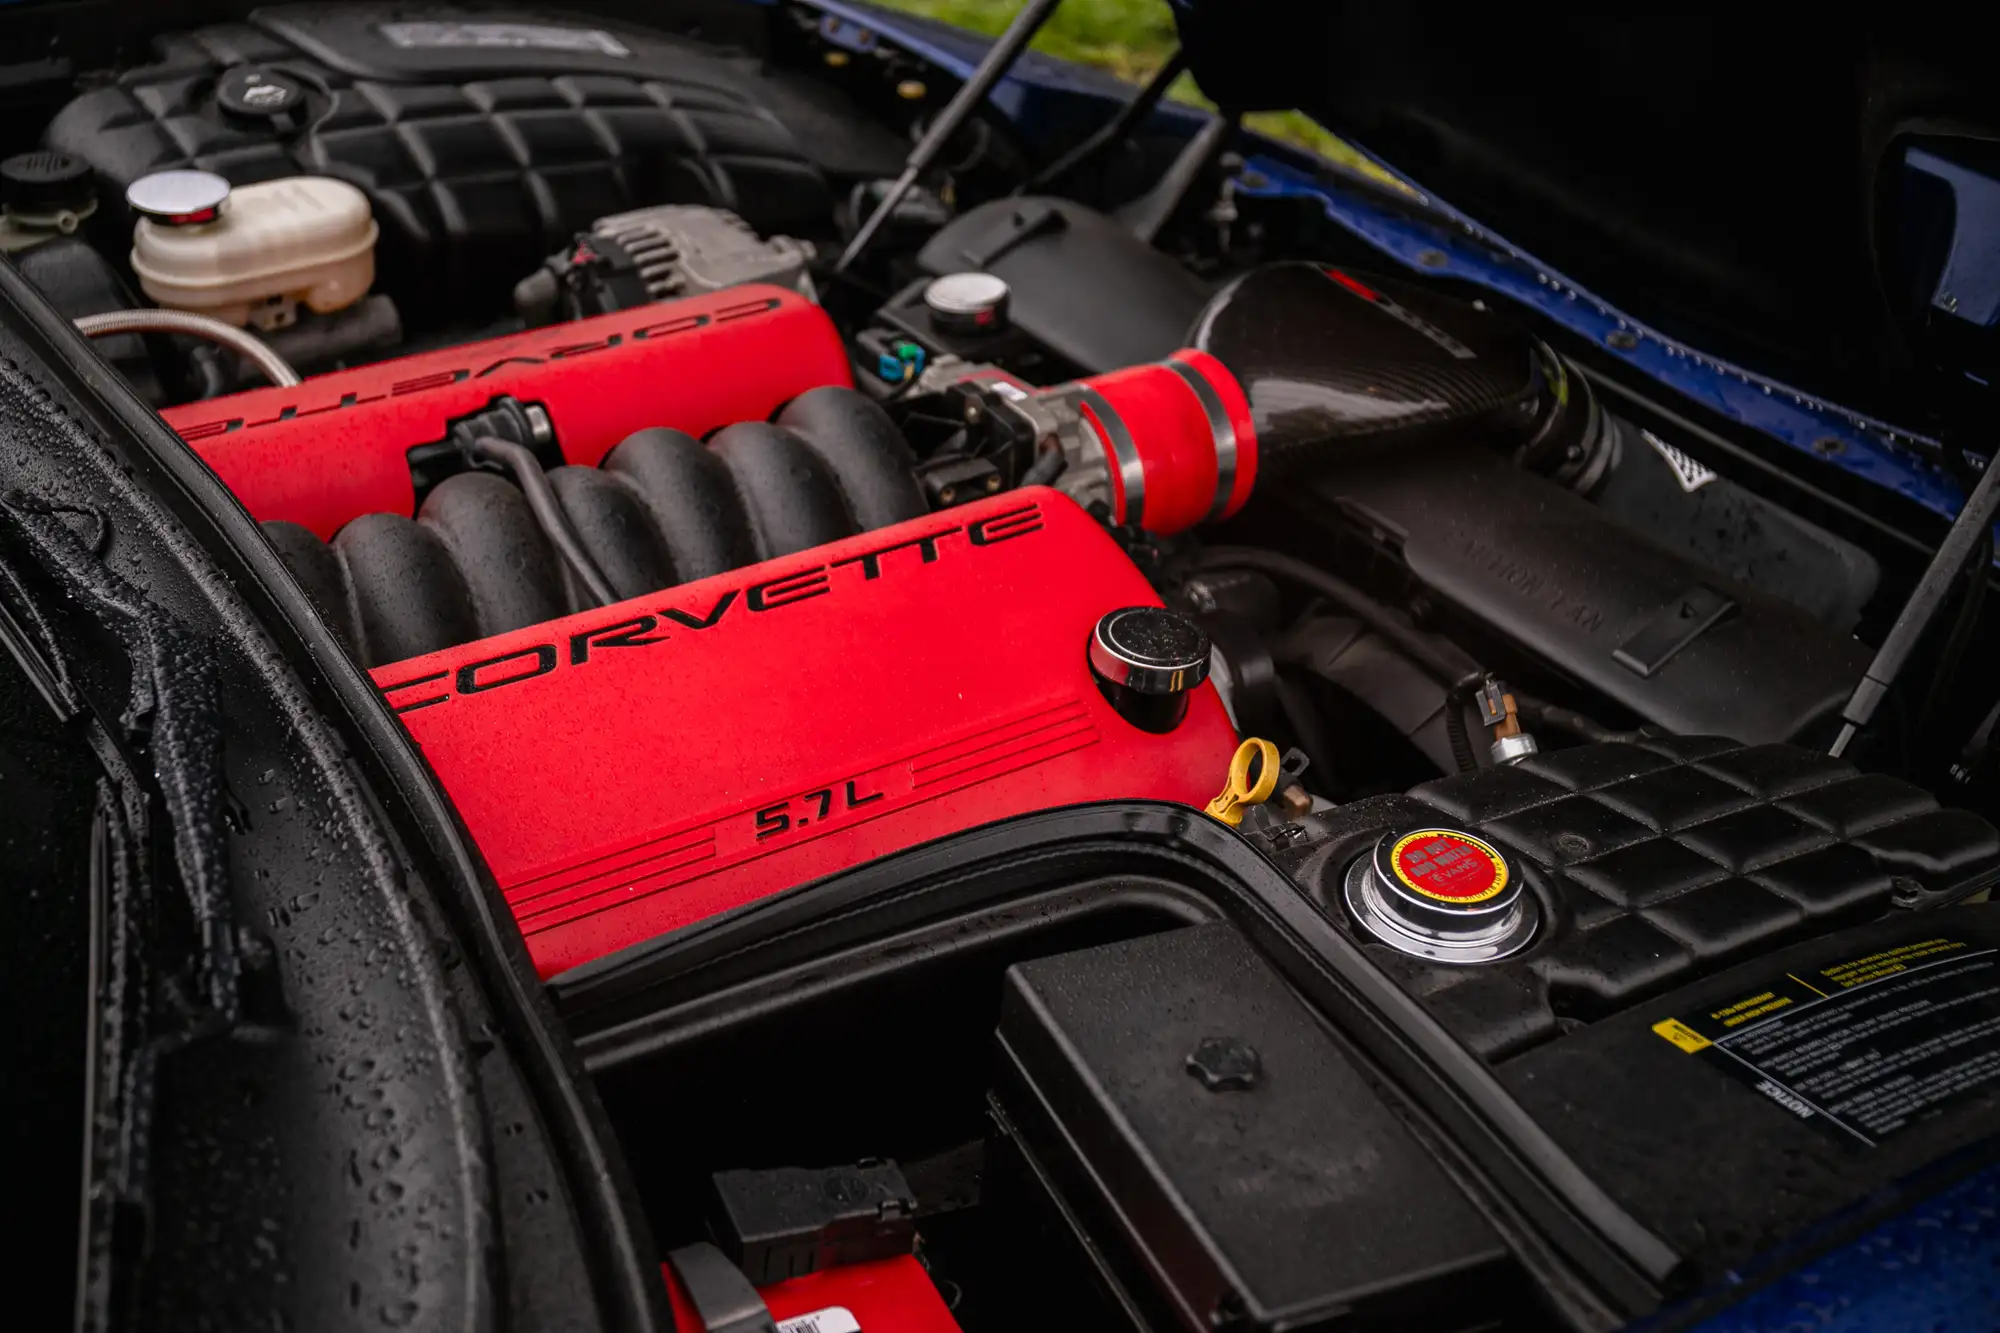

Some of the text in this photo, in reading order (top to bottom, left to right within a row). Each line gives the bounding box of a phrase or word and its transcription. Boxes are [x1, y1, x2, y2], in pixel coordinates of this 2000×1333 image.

[177, 297, 781, 440] CORVETTE
[382, 502, 1044, 714] CORVETTE
[755, 780, 884, 842] 5.7L
[1405, 839, 1451, 863] DO NOT
[1410, 862, 1437, 877] ADD
[1433, 846, 1475, 866] WATER
[1432, 859, 1478, 882] EVANS
[1464, 885, 1498, 900] REMOVE
[1755, 1080, 1815, 1119] NOTICE
